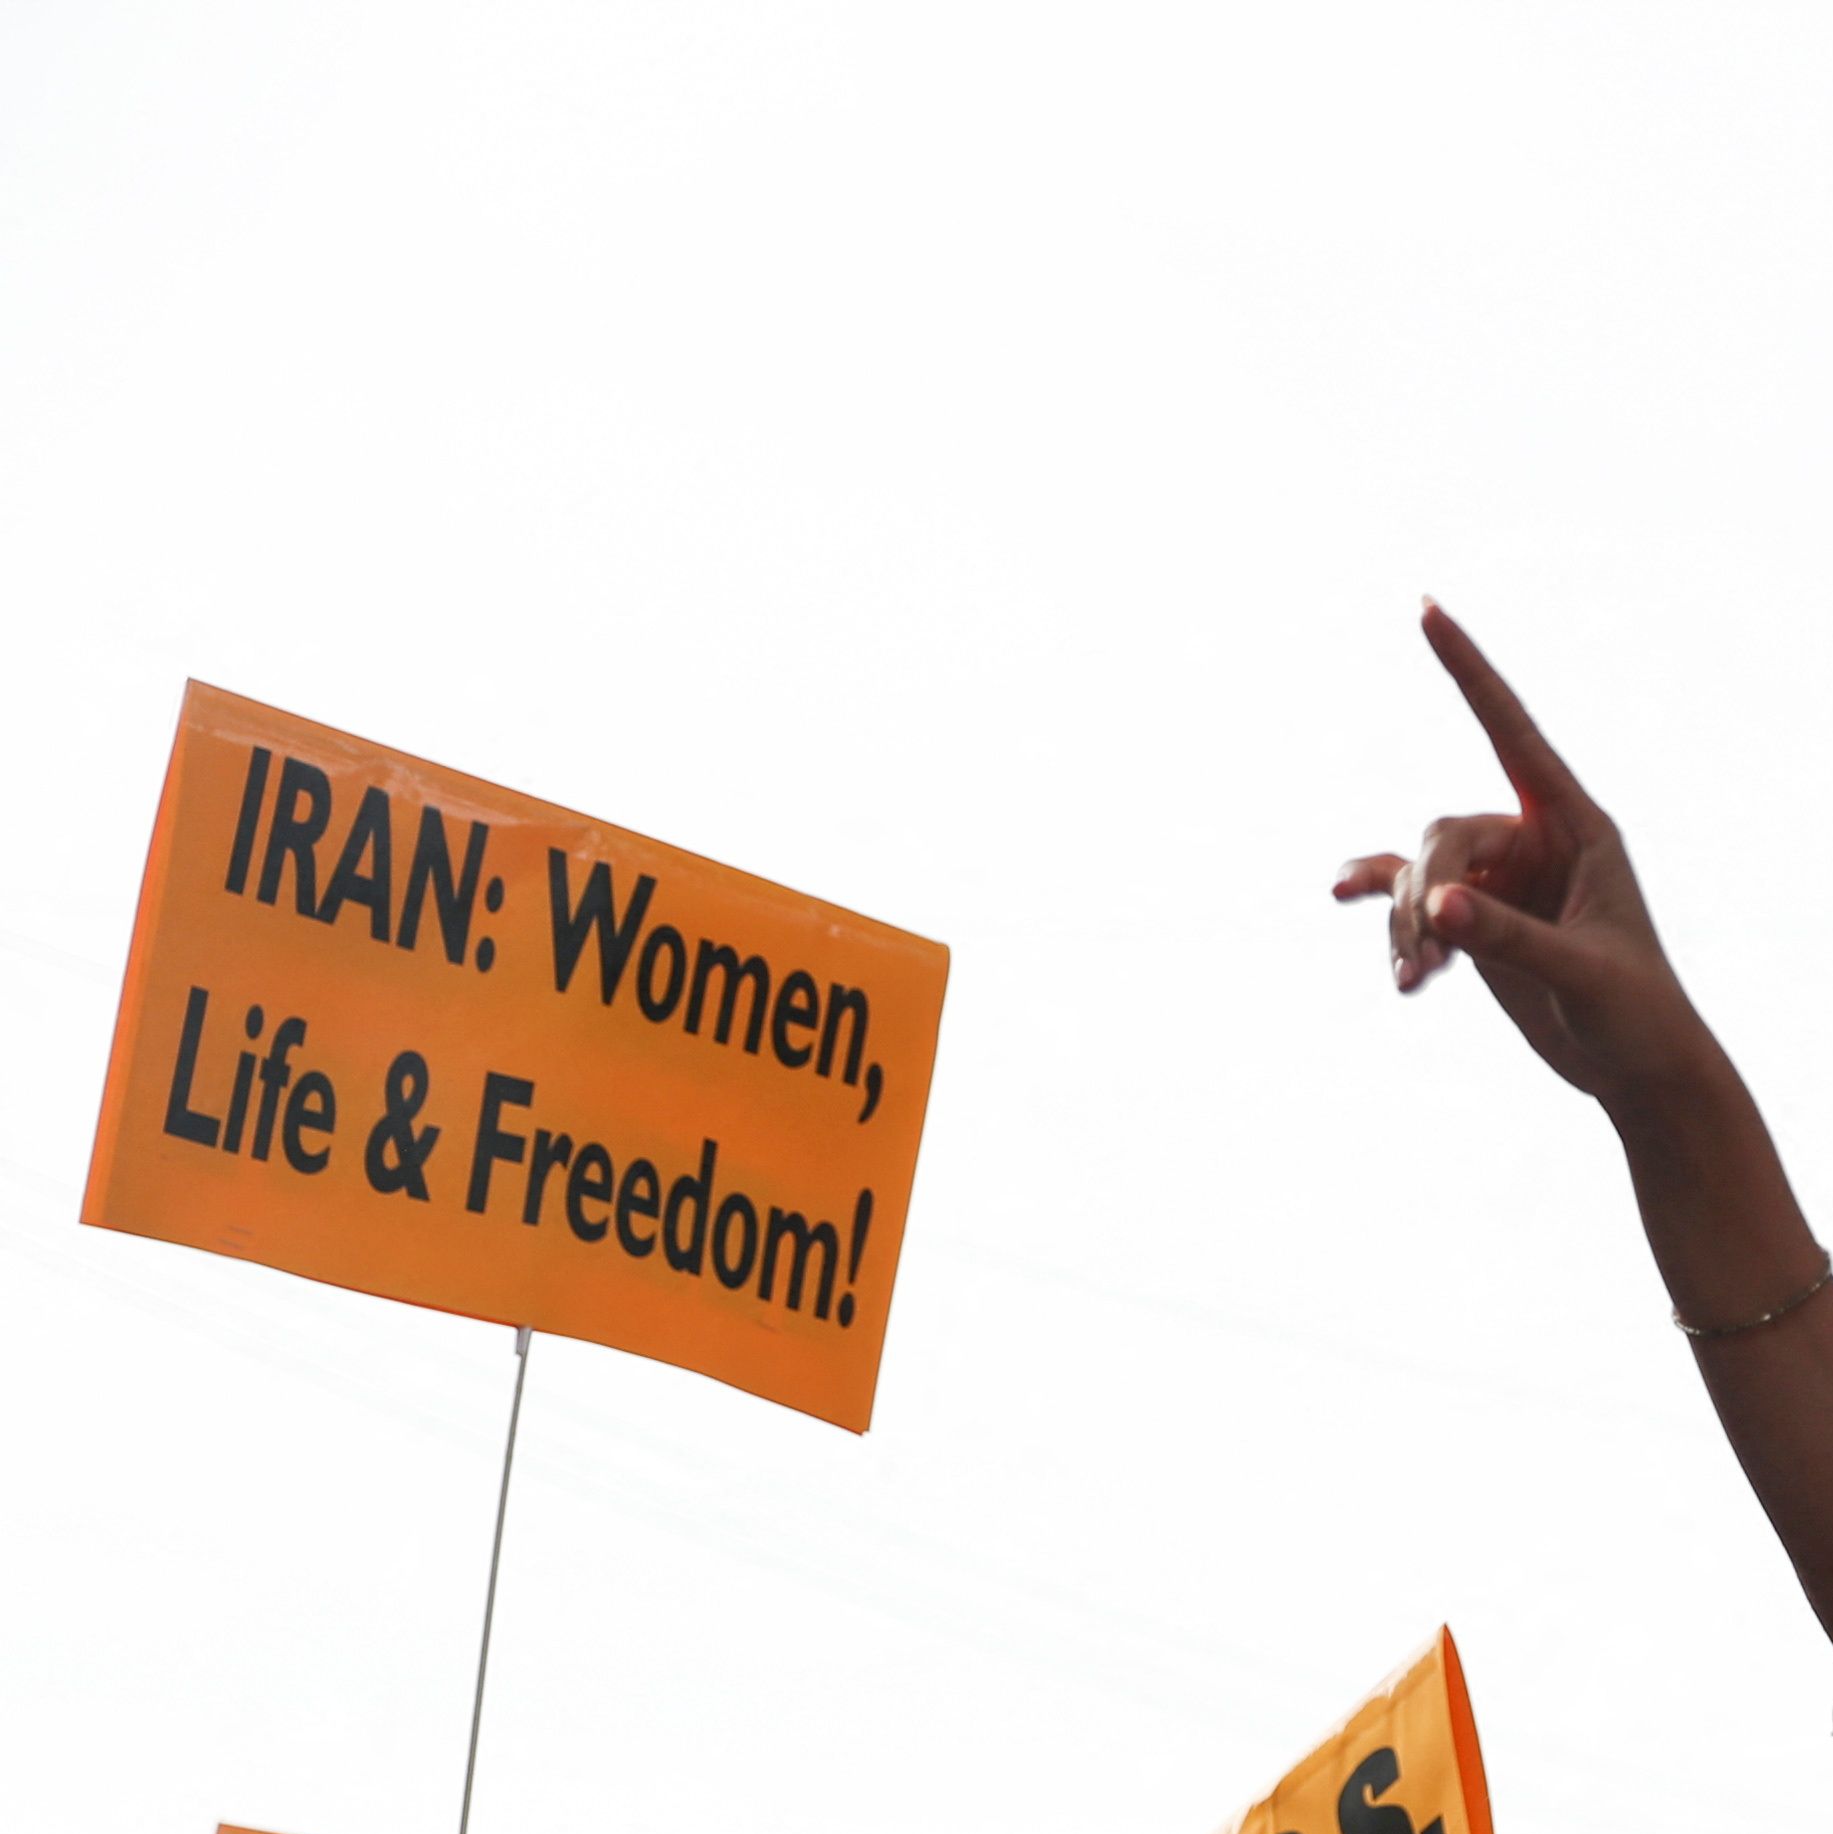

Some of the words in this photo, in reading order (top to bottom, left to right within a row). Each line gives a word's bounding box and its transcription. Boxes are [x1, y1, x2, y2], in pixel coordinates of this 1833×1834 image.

[225, 745, 505, 973] IRAN:
[546, 847, 885, 1123] Women,
[162, 985, 337, 1175] Life
[363, 1049, 442, 1202] &
[465, 1071, 874, 1328] Freedom!
